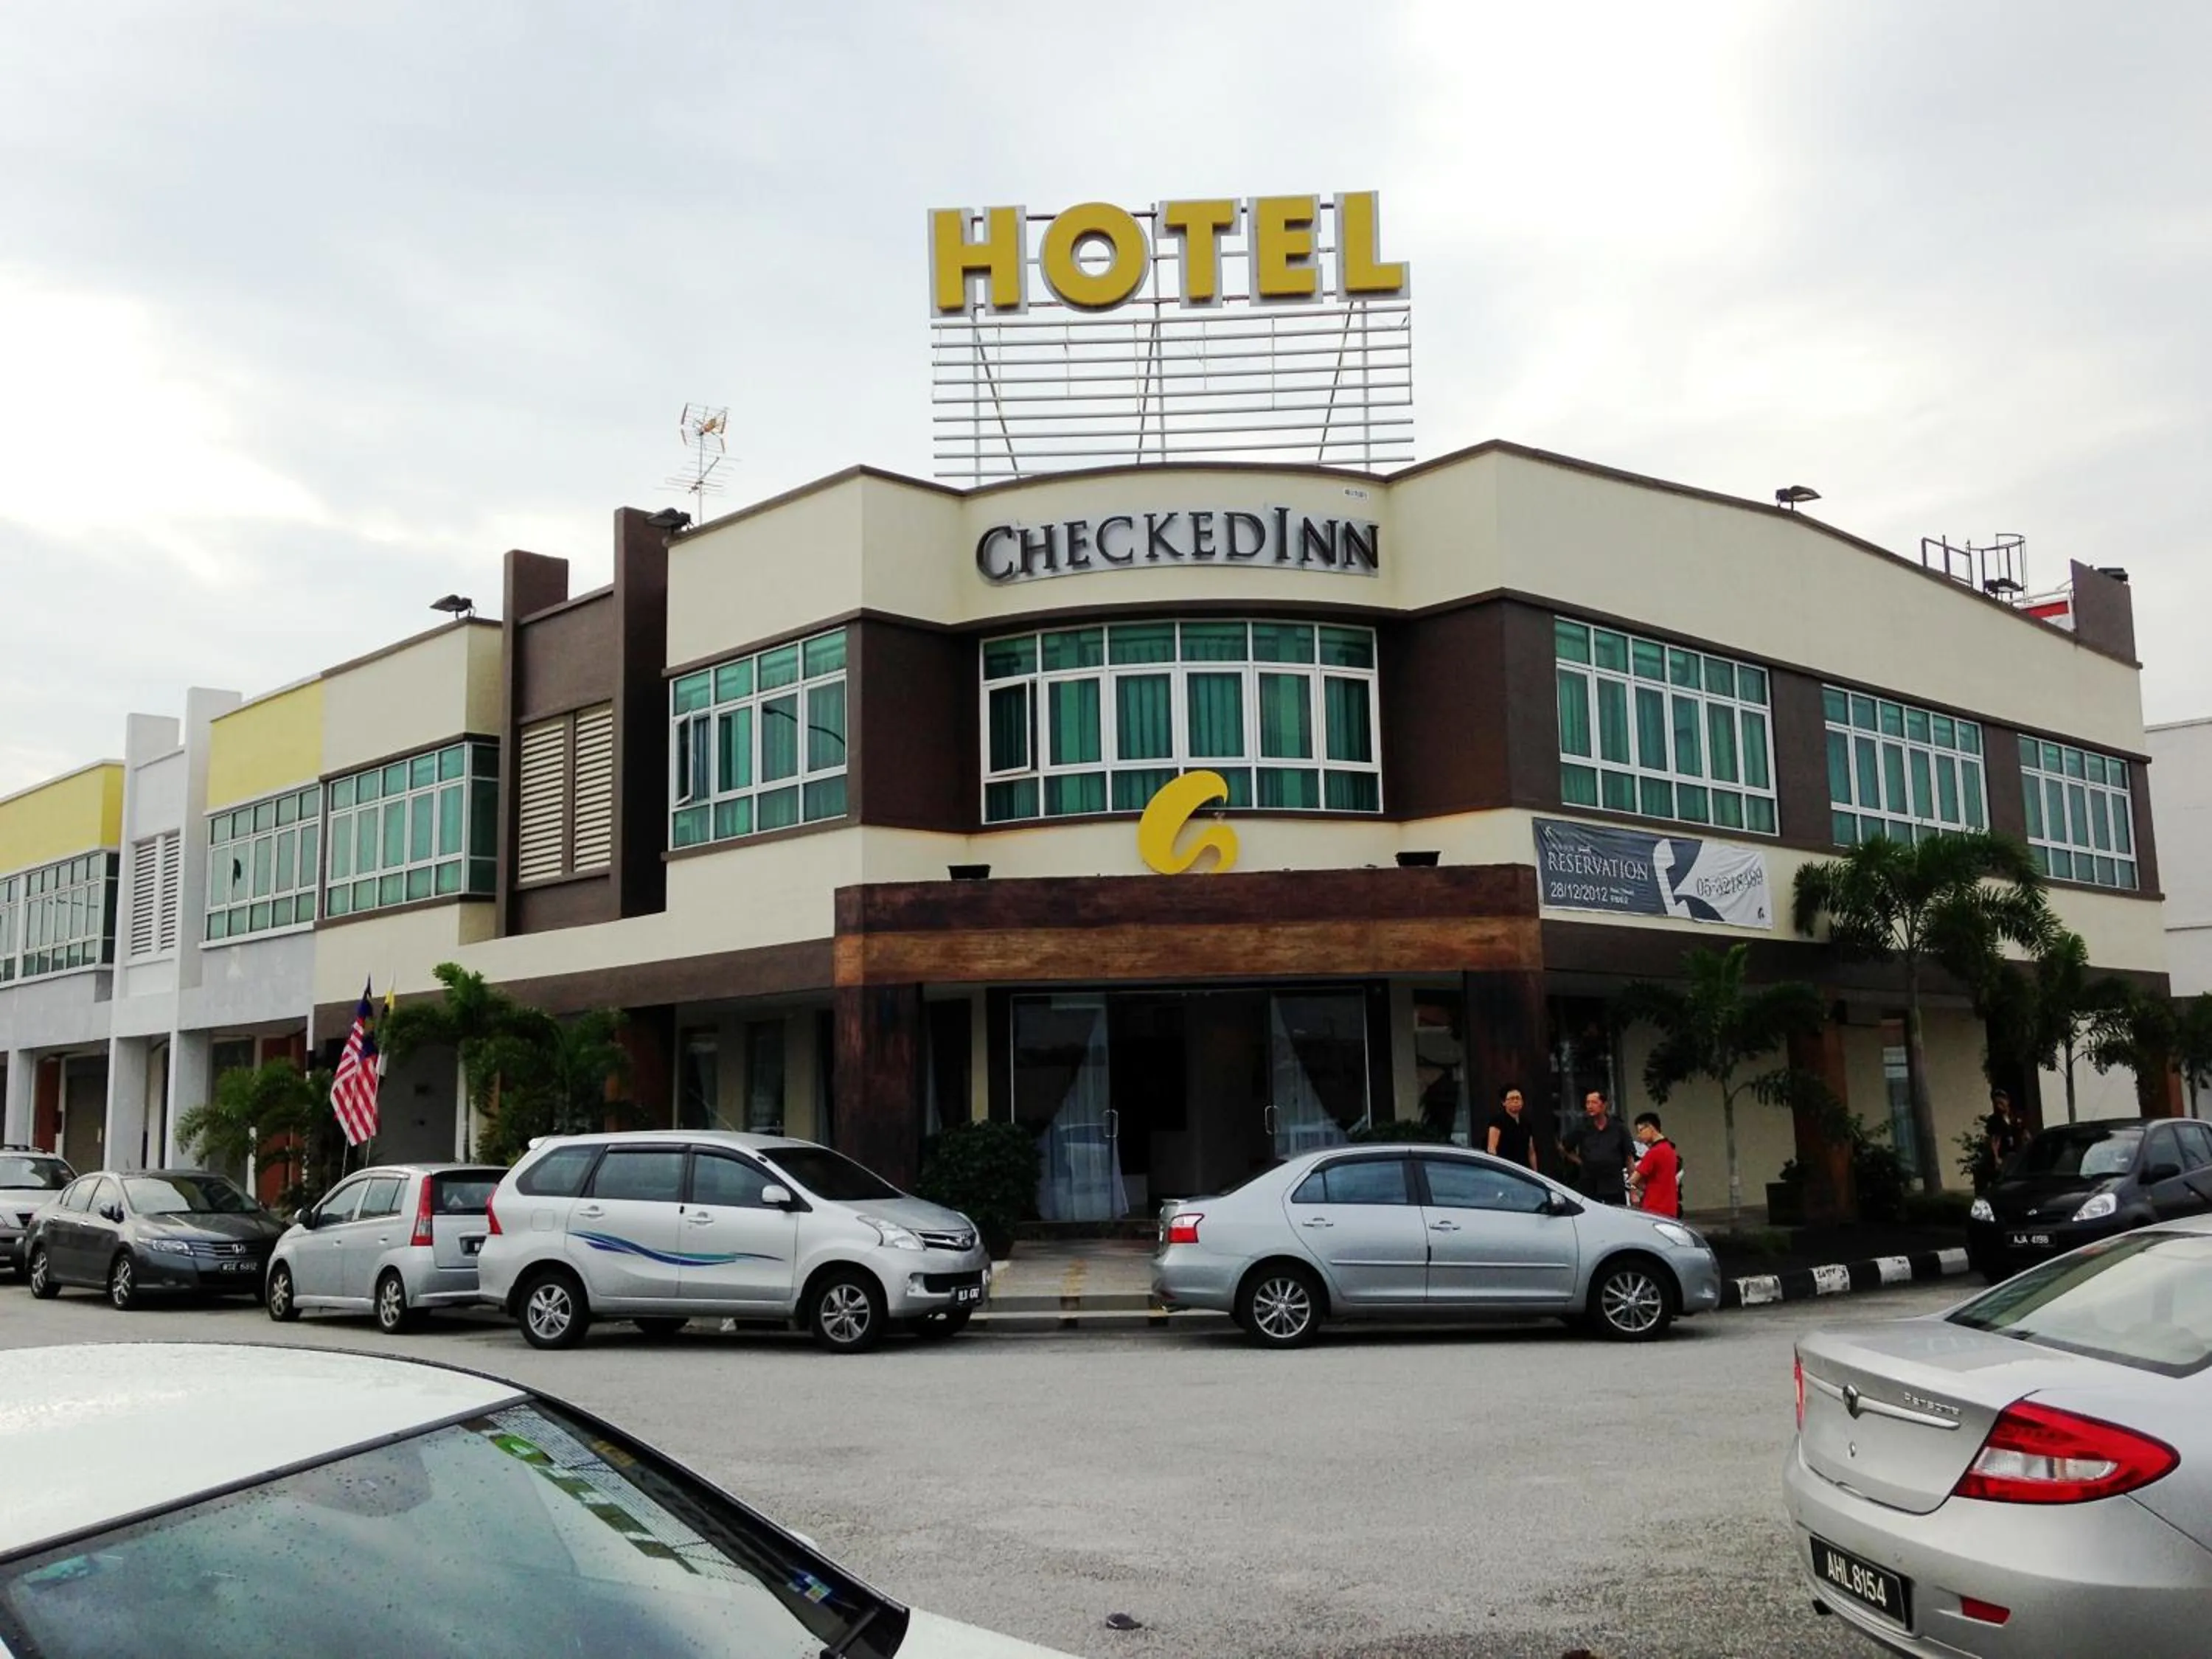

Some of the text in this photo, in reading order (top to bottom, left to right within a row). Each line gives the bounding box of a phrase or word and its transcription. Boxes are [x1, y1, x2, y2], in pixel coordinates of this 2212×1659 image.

[929, 191, 1407, 314] HOTEL
[1548, 851, 1649, 881] RESERVATION
[1827, 1551, 1887, 1607] AHL 8154
